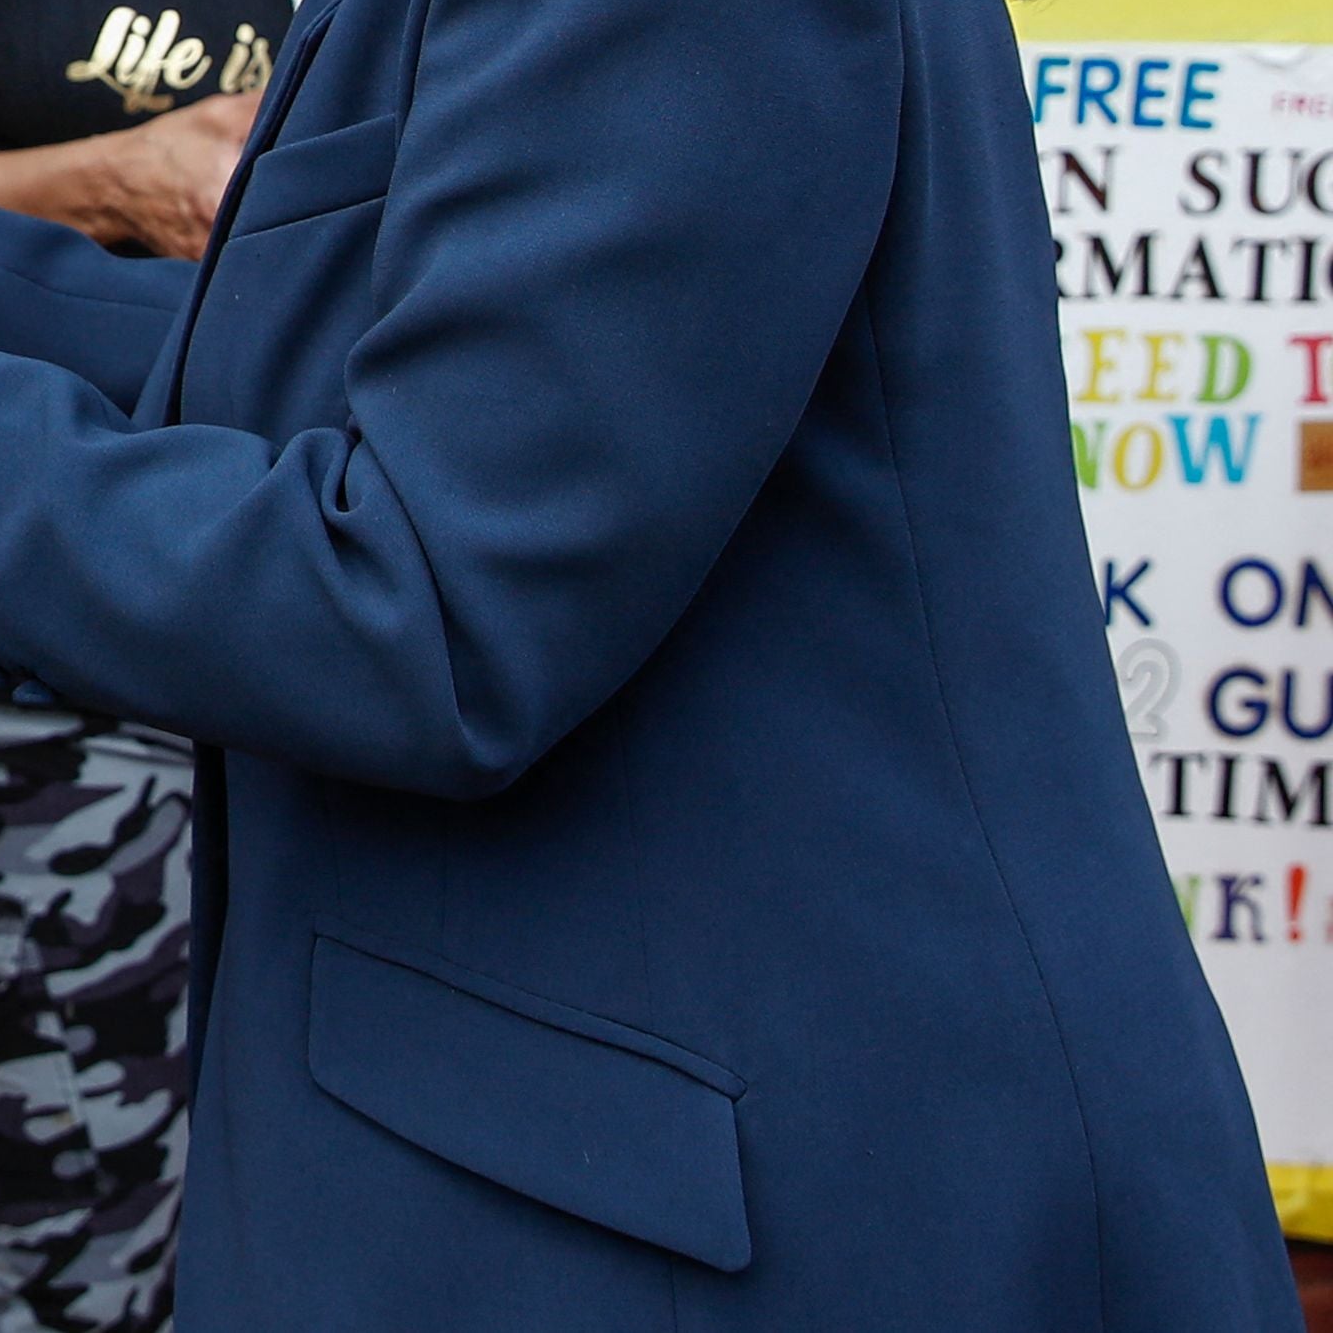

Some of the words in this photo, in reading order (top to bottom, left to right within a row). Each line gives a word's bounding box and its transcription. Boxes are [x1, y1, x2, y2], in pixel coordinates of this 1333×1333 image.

[66, 6, 214, 113] Life
[1034, 57, 1220, 129] FREE
[1053, 232, 1333, 303] MATI
